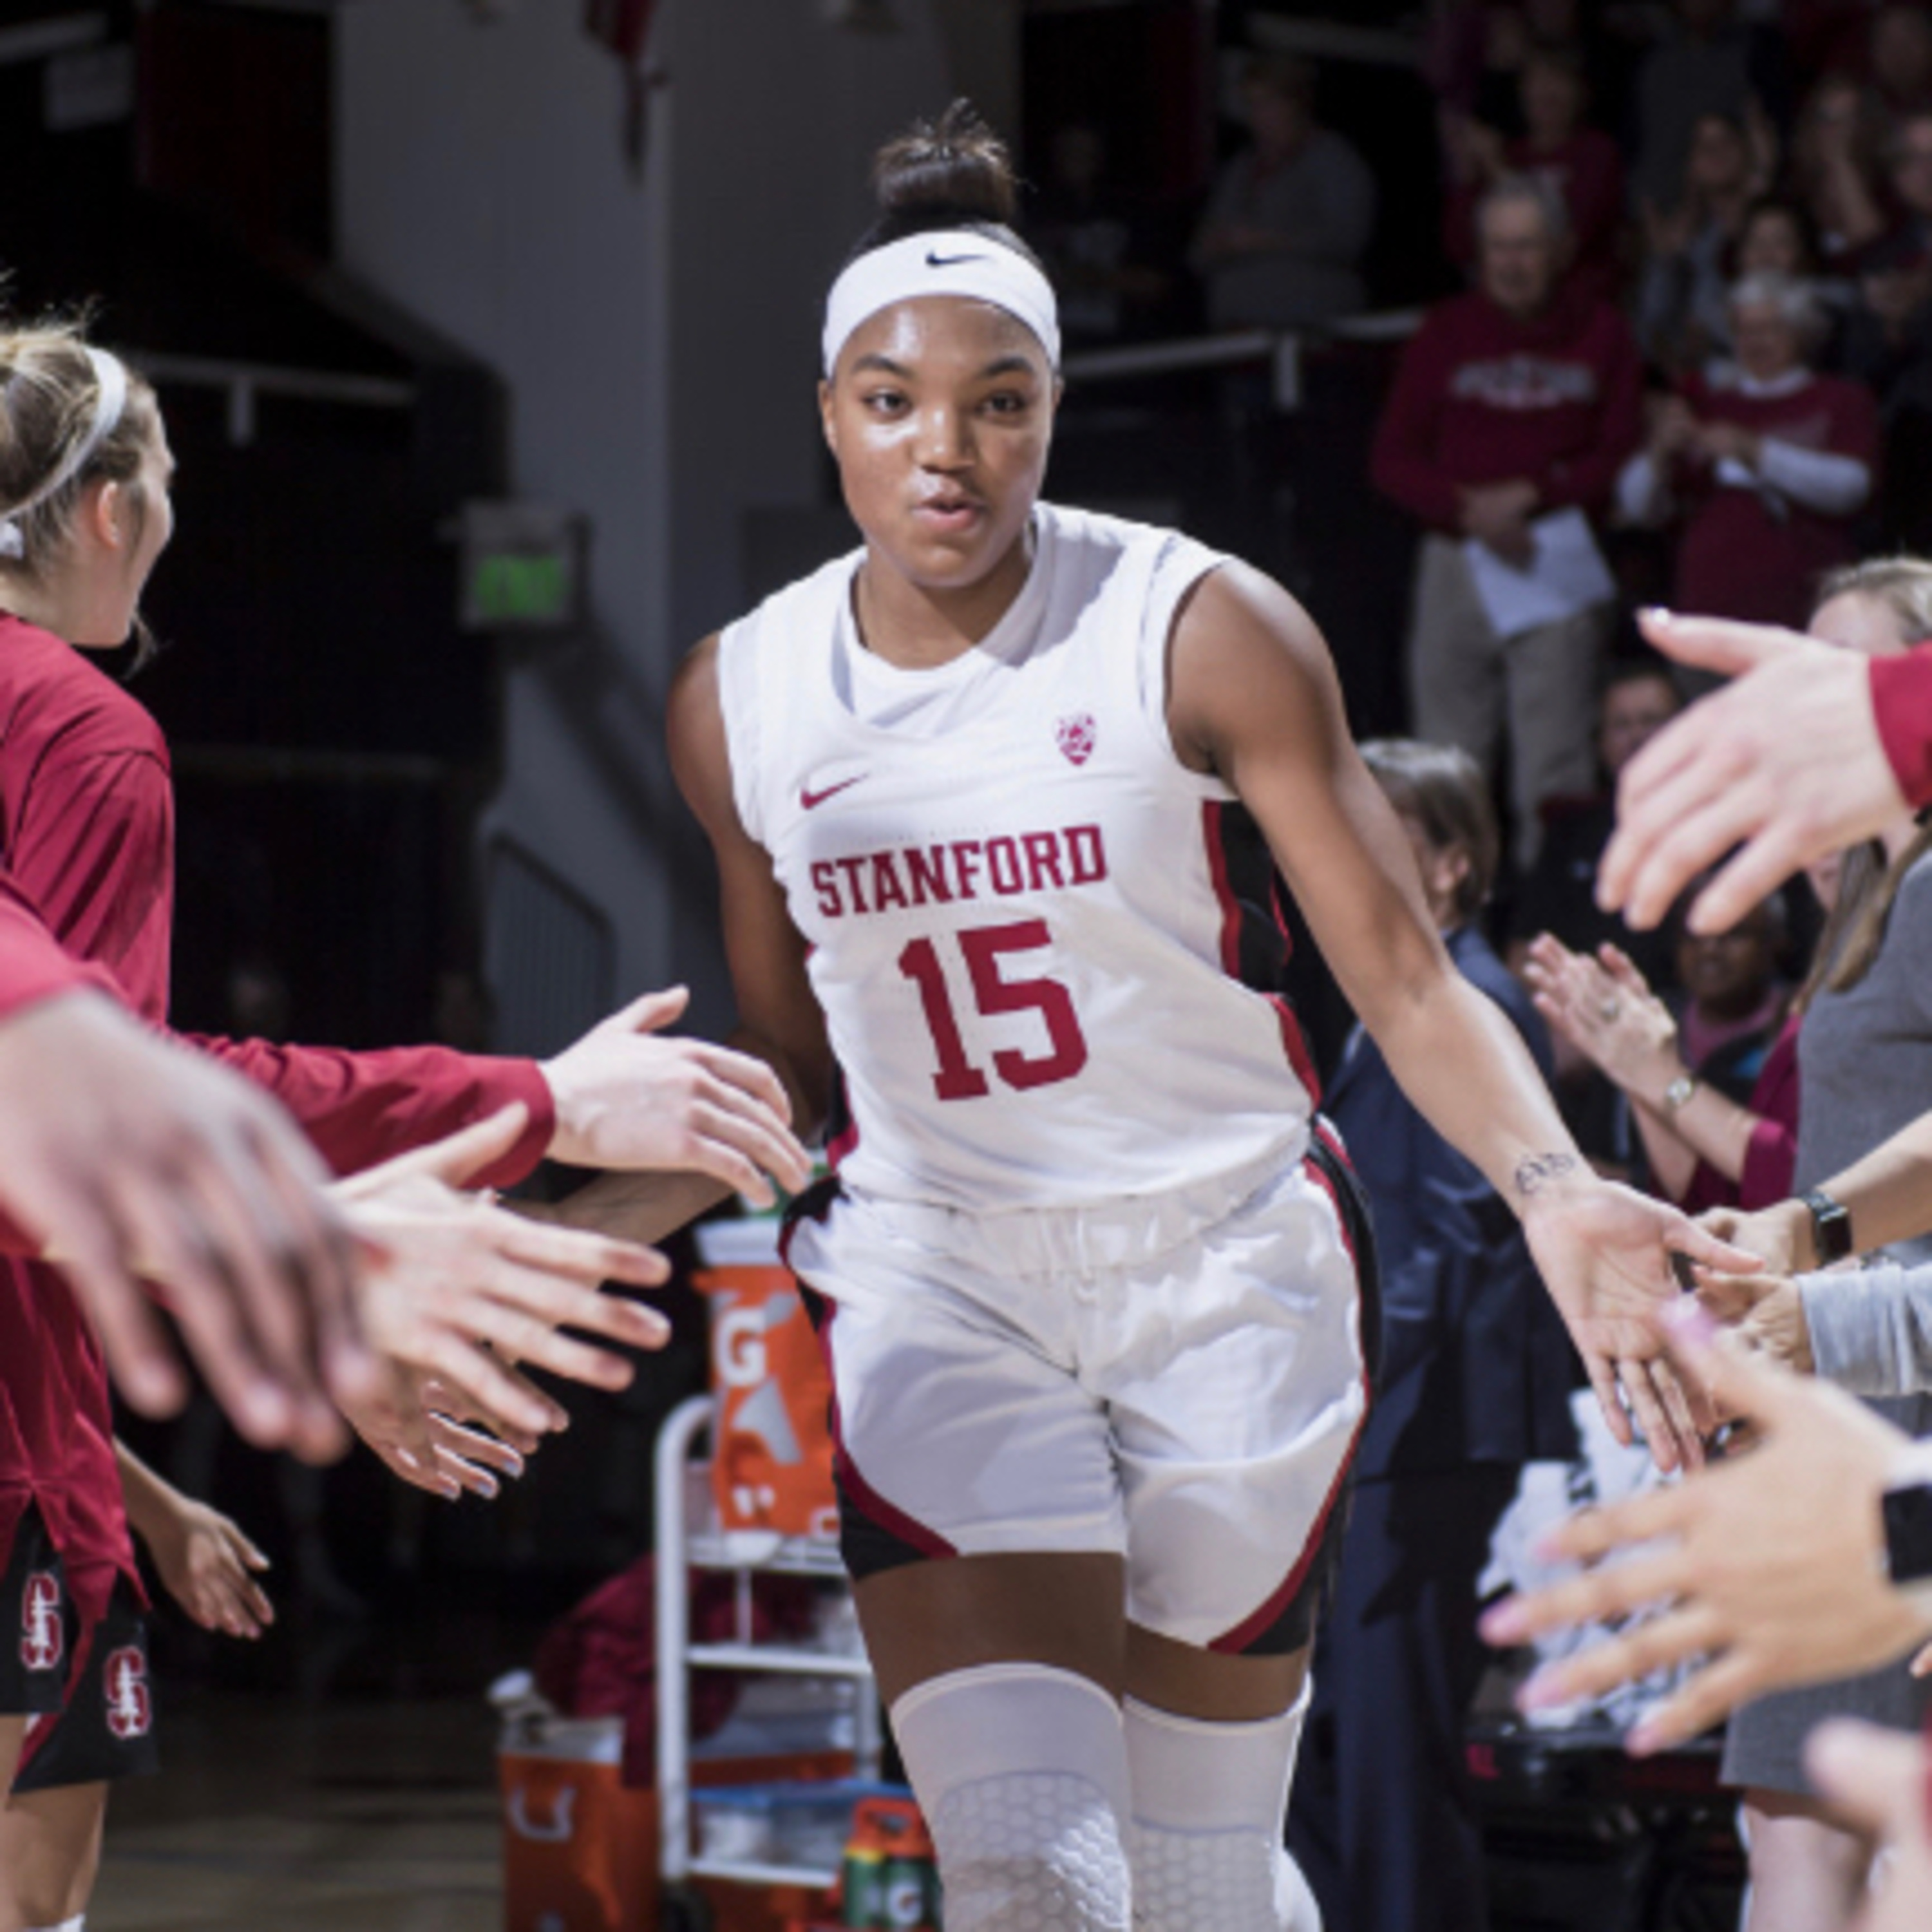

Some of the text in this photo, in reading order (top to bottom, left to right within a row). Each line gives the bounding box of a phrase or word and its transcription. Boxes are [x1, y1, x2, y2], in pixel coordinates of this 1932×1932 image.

[810, 822, 1106, 917] STANFORD
[898, 918, 1088, 1101] 15
[715, 1307, 767, 1387] G
